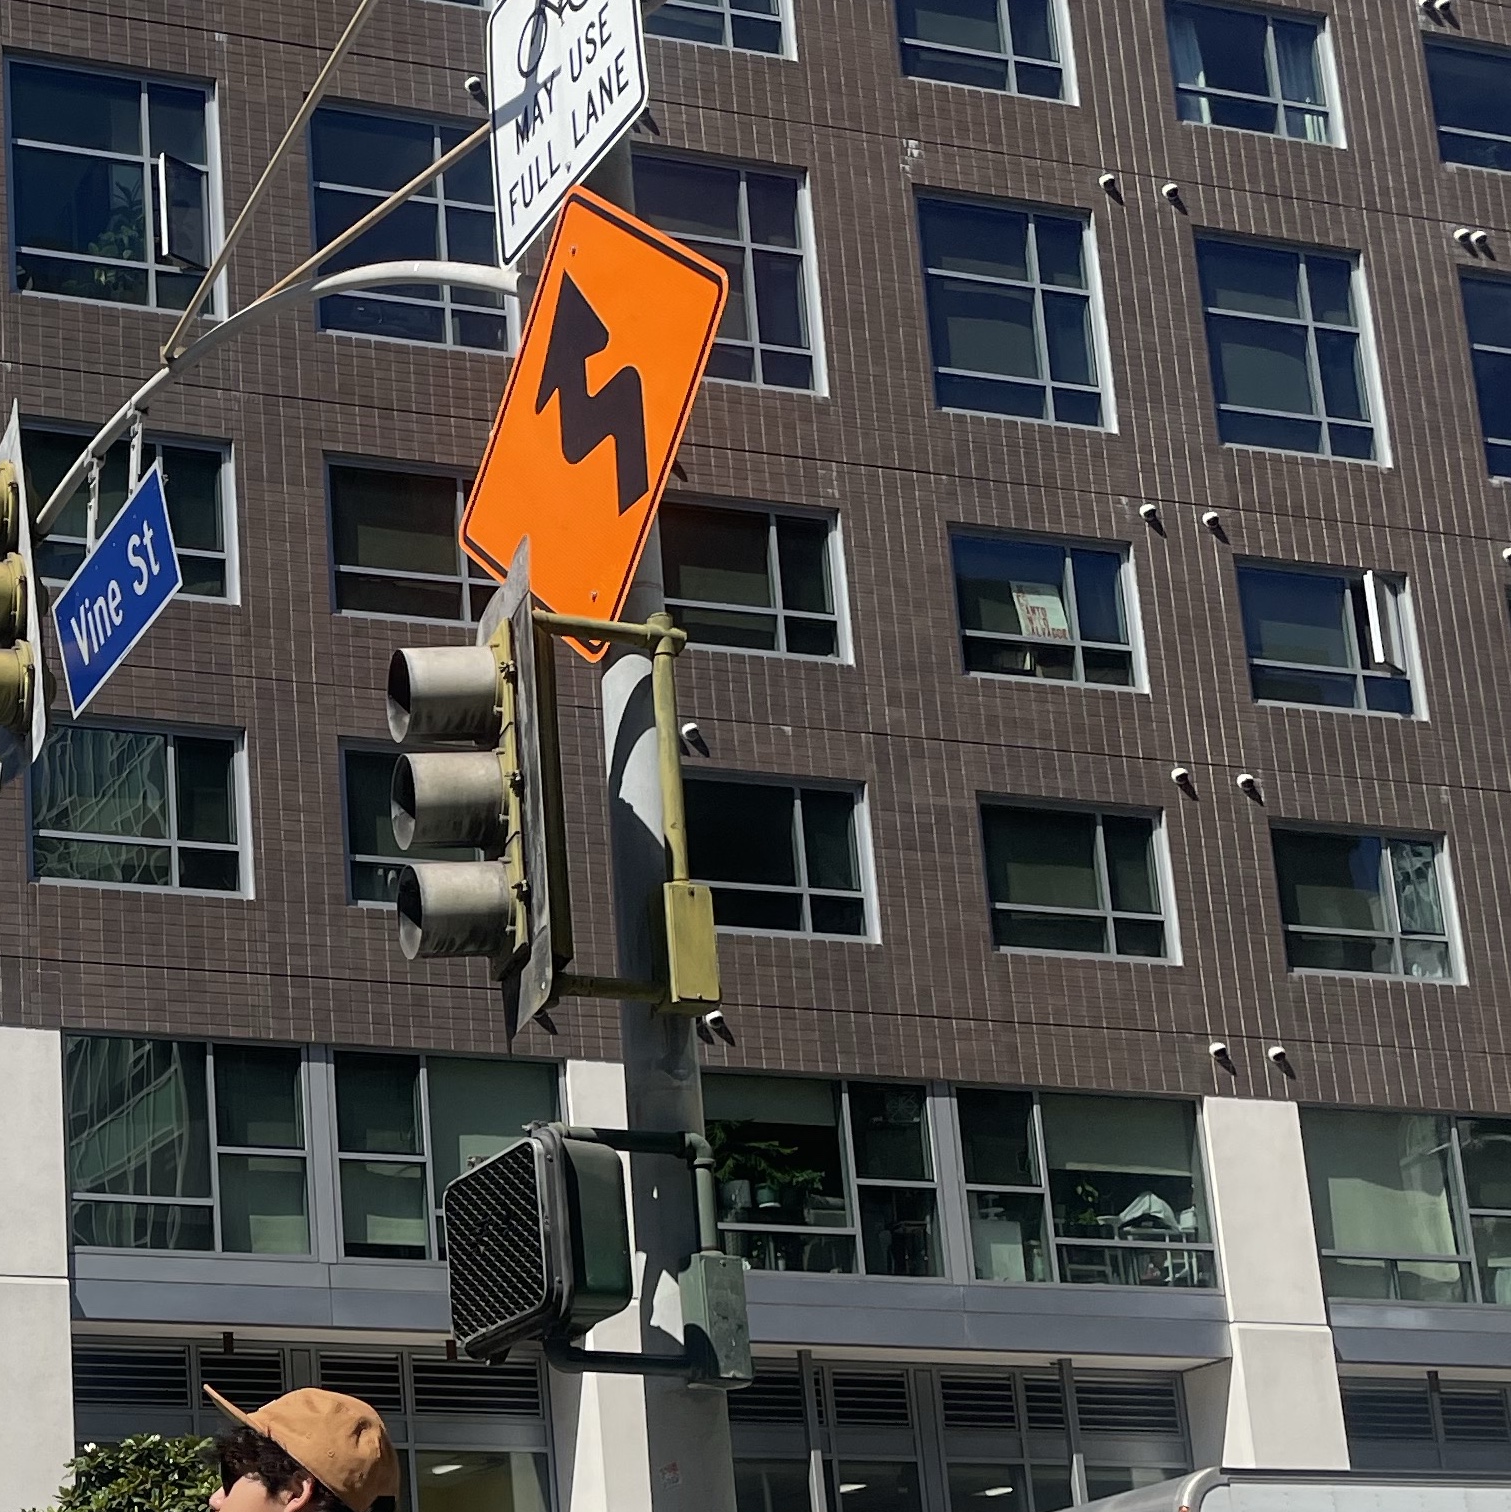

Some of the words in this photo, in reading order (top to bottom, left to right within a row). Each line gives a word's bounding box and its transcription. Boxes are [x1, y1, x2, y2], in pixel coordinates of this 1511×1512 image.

[508, 140, 561, 226] FULL
[571, 48, 629, 149] LANE
[514, 77, 557, 156] MAY
[569, 2, 612, 83] USE
[70, 579, 123, 666] Vine
[127, 519, 160, 596] St
